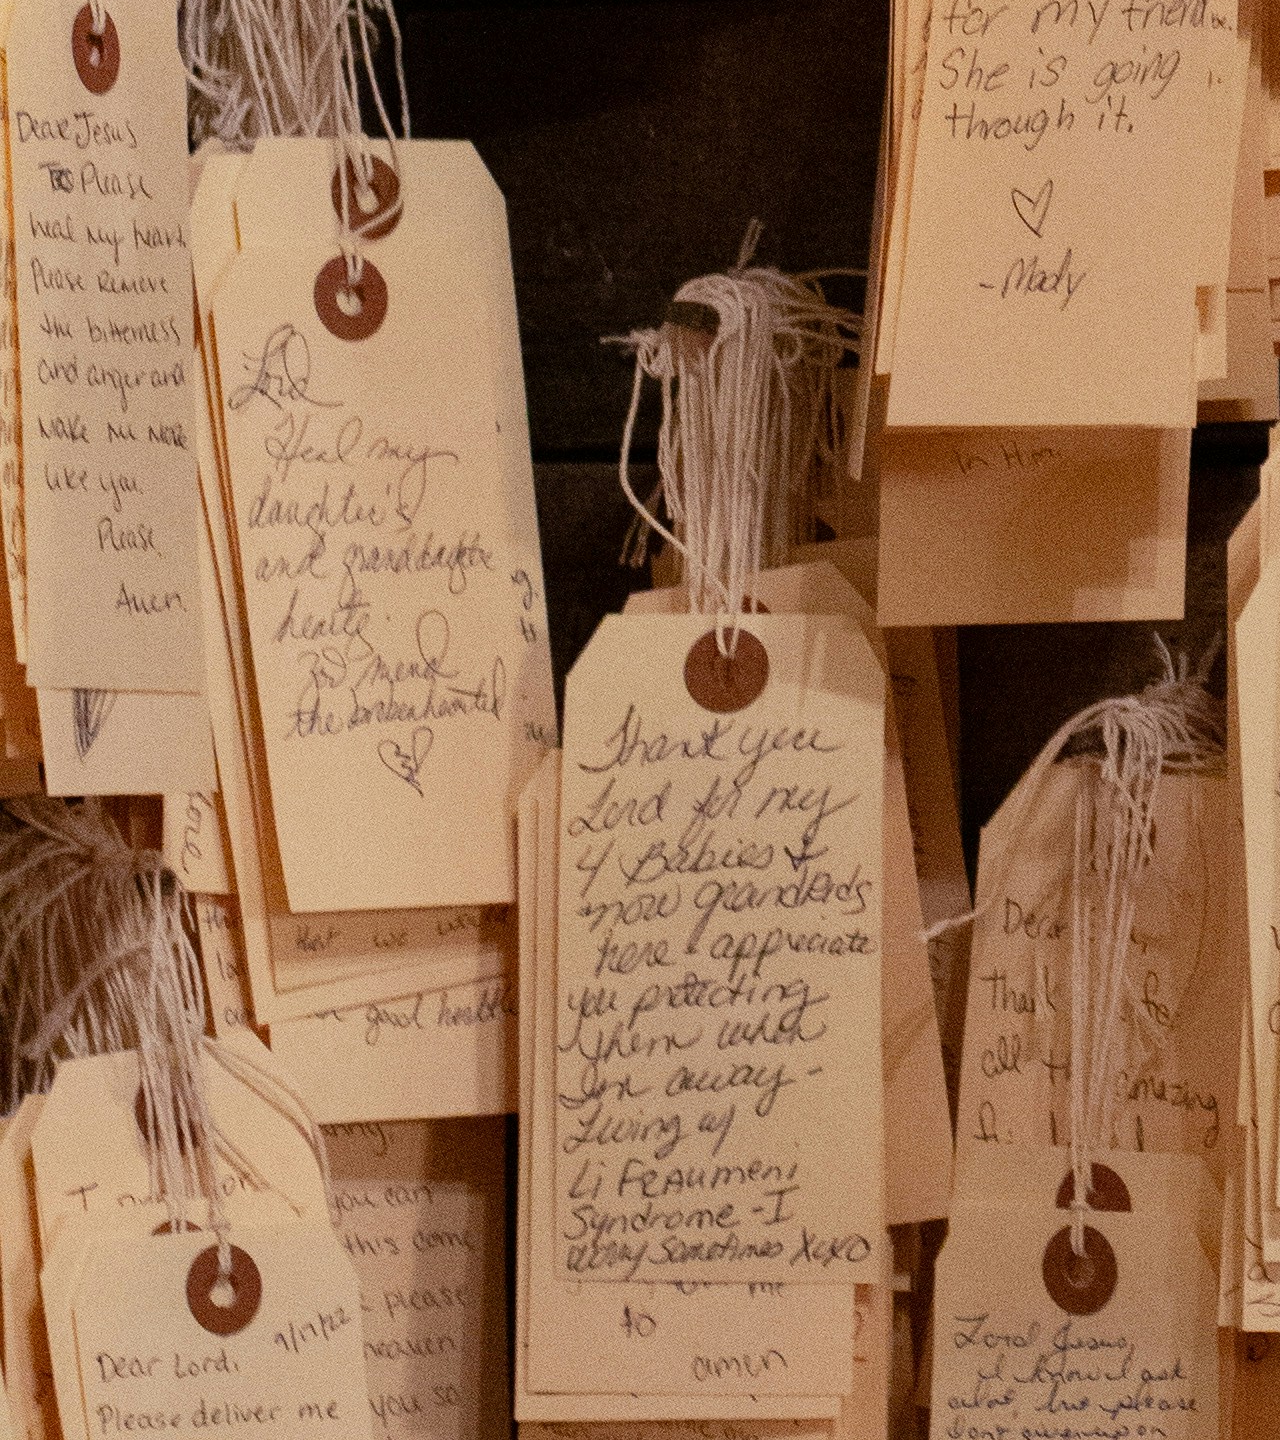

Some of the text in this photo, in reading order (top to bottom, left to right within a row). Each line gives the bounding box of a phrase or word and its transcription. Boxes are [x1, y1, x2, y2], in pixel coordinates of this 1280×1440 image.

[1028, 47, 1068, 89] is
[1087, 50, 1182, 108] going
[73, 110, 138, 150] Jesus
[944, 99, 1075, 151] through
[96, 1352, 160, 1382] Dear
[96, 1399, 338, 1434] Please deliver me
